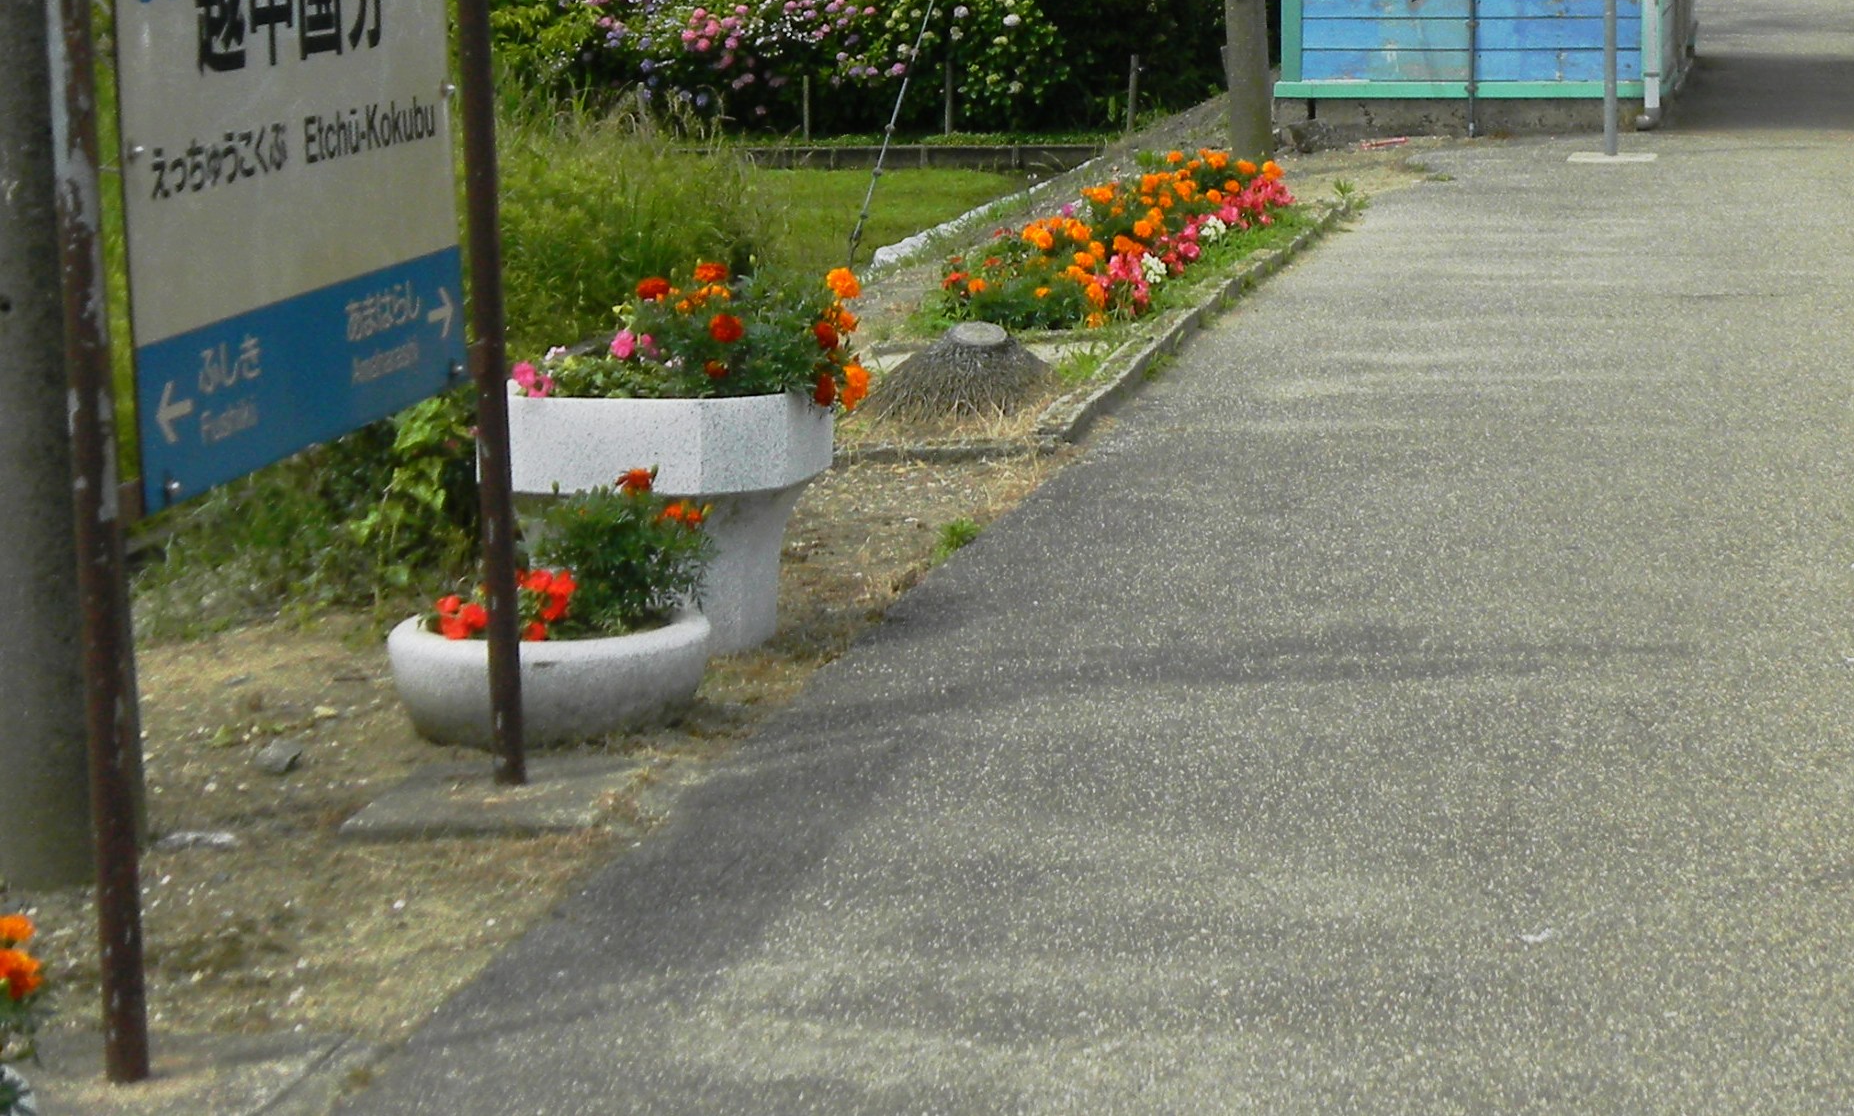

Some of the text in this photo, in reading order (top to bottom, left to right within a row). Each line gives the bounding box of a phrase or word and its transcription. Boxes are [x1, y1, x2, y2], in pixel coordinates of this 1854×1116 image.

[151, 121, 288, 200] えっちゅうこくぶ
[304, 96, 436, 165] Etchū-Kokubu
[345, 280, 420, 342] あまはらし
[199, 334, 261, 394] ふしき
